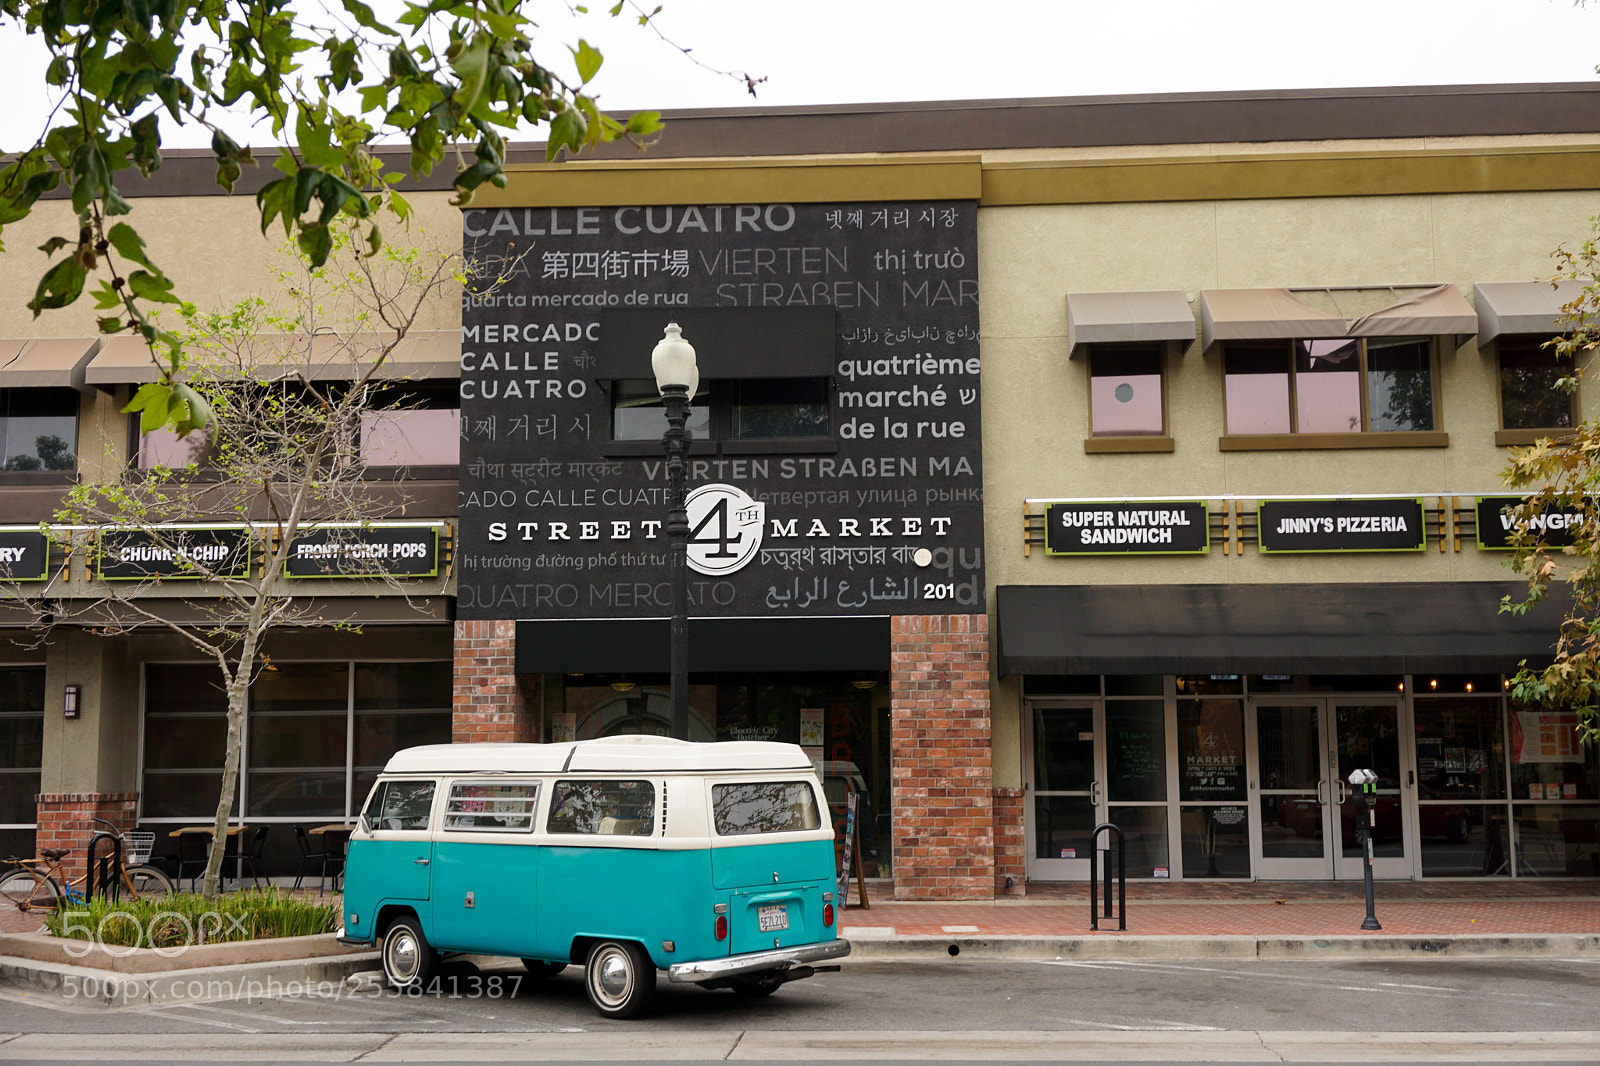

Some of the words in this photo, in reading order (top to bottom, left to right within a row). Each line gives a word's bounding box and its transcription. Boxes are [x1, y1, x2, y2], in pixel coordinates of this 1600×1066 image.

[463, 206, 600, 238] CALLE
[614, 203, 796, 235] CUATRO
[870, 208, 909, 229] 거리
[918, 207, 959, 228] 시장
[541, 249, 690, 281] 第四街市場
[699, 246, 848, 276] VIERTEN
[873, 248, 907, 275] thị
[462, 292, 527, 311] quarta
[532, 290, 619, 306] mercado
[625, 290, 649, 305] de
[654, 292, 688, 305] rua
[903, 279, 979, 307] MAR
[460, 351, 559, 371] CALLE
[838, 352, 981, 381] quatrième
[460, 379, 586, 399] CUATRO
[838, 384, 947, 407] marché
[506, 413, 557, 441] 거리
[839, 417, 875, 439] de
[884, 416, 908, 438] la
[917, 420, 966, 438] rue
[641, 460, 769, 481] VIRTEN
[929, 456, 974, 476] MA
[525, 488, 597, 507] CALLE
[602, 487, 675, 505] CUAT
[857, 487, 918, 508] улица
[488, 520, 662, 541] STREET
[770, 516, 952, 538] MARKET
[1062, 511, 1114, 527] SUPER
[1117, 510, 1191, 526] NATURAL
[1276, 517, 1334, 534] JINNY'S
[1337, 516, 1408, 532] PIZZERIA
[1080, 528, 1172, 544] SANDWICH
[120, 545, 229, 561] CHUNK-N-CHIP
[297, 544, 339, 559] FRONT
[345, 543, 388, 559] PORCH
[392, 543, 427, 558] POPS
[481, 553, 531, 571] trường
[535, 552, 584, 571] đường
[932, 546, 981, 577] qu
[766, 576, 828, 608] الرابع
[837, 576, 918, 608] الشارع
[923, 583, 955, 599] 201
[956, 575, 986, 605] d
[762, 724, 780, 740] City
[1187, 755, 1236, 764] MARKET
[760, 914, 787, 928] 5EZL210
